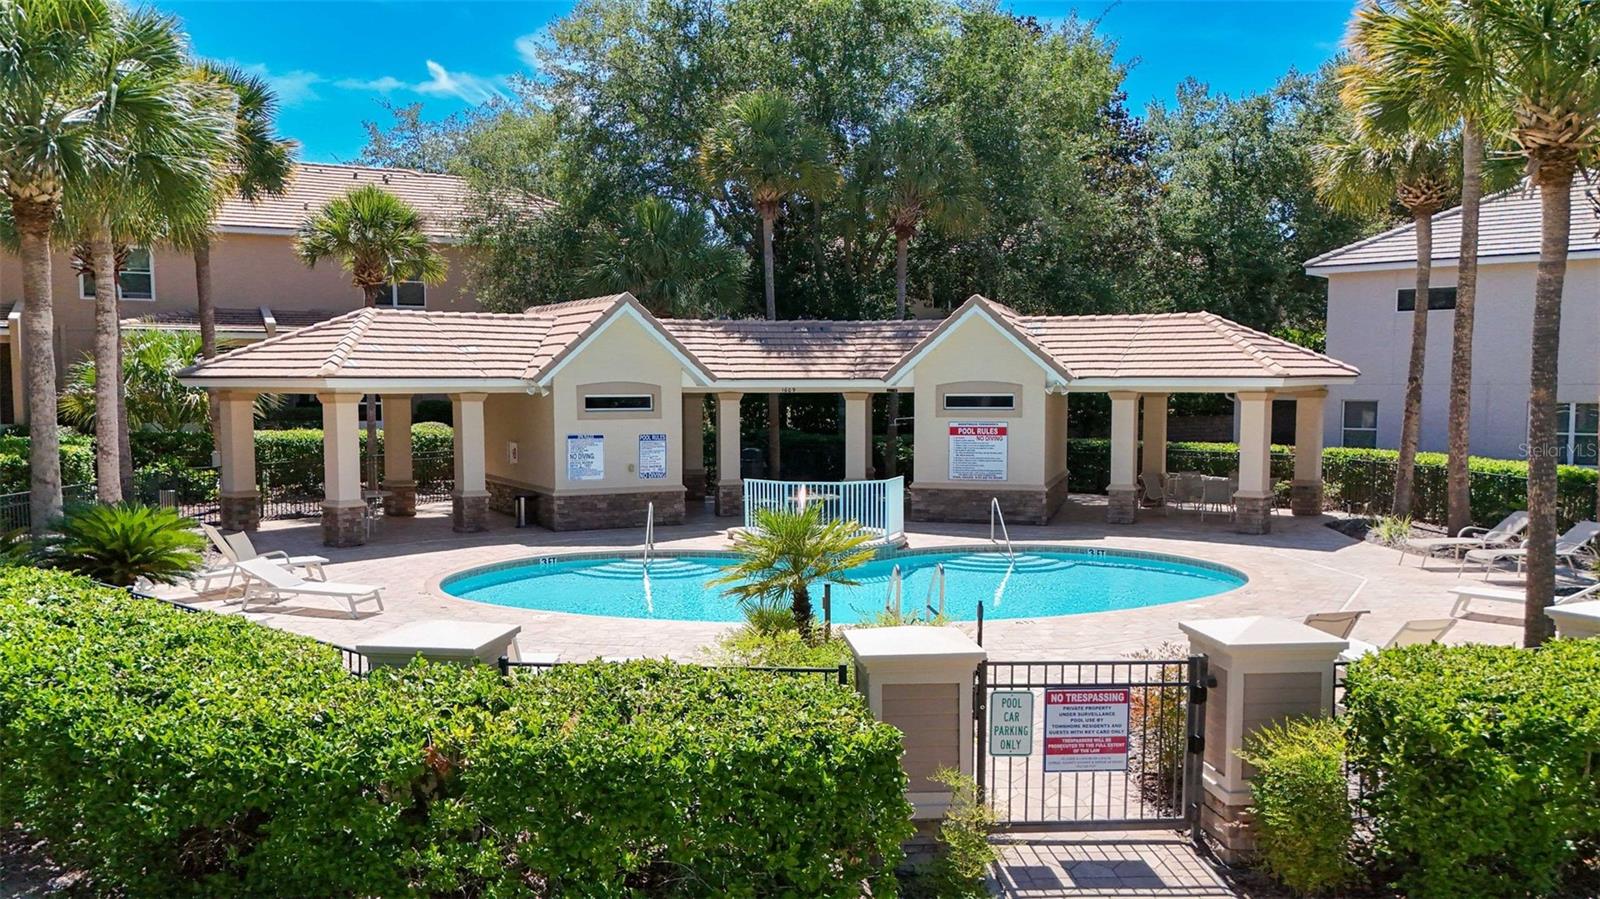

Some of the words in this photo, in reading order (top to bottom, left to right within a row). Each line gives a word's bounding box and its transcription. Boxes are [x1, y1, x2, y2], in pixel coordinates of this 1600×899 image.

[1051, 694, 1063, 702] NO
[1065, 692, 1124, 702] TRESPASSING
[1001, 698, 1022, 708] POOL
[1004, 712, 1020, 722] CAR
[994, 725, 1029, 736] PARKING
[1000, 739, 1022, 750] ONLY
